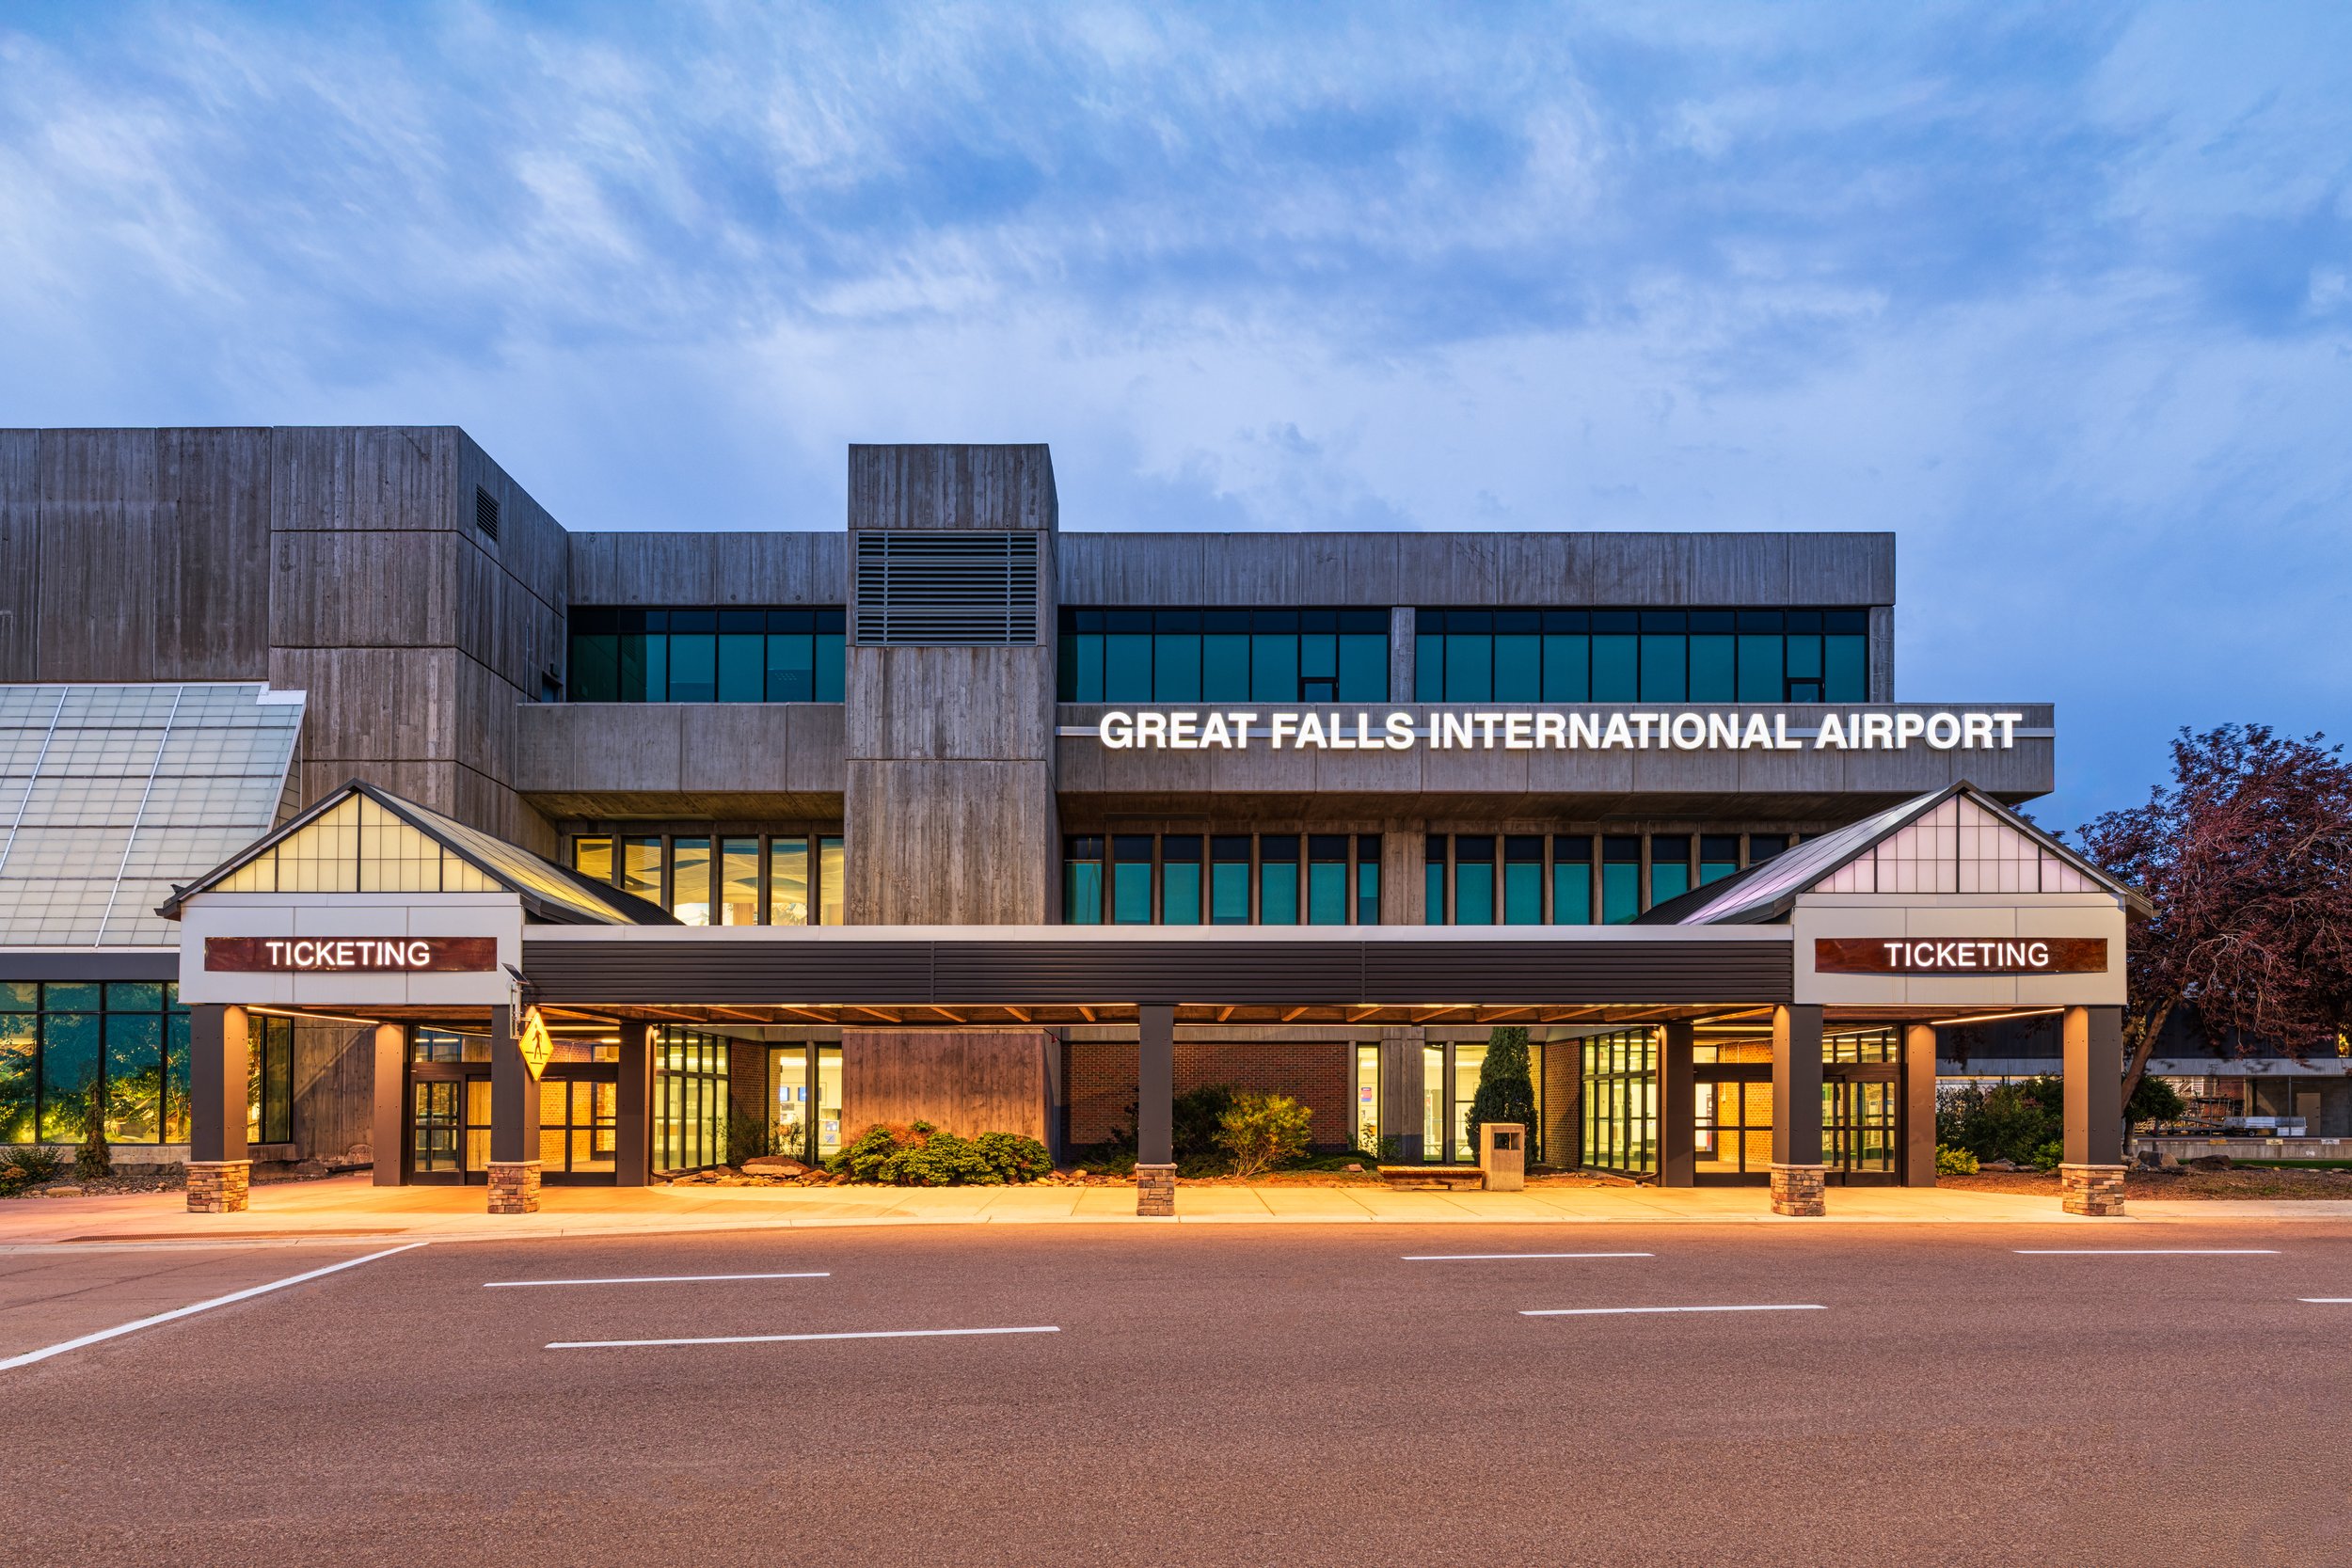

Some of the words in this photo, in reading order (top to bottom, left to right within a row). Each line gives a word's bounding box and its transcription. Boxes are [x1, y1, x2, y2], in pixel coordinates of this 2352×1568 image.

[1099, 711, 1258, 750] GREAT
[1272, 712, 1416, 750] FALLS
[1430, 712, 1803, 750] INTERNATIONAL
[1815, 712, 2023, 750] AIRPORT
[265, 942, 431, 967] TICKETING
[1883, 942, 2049, 967] TICKETING
